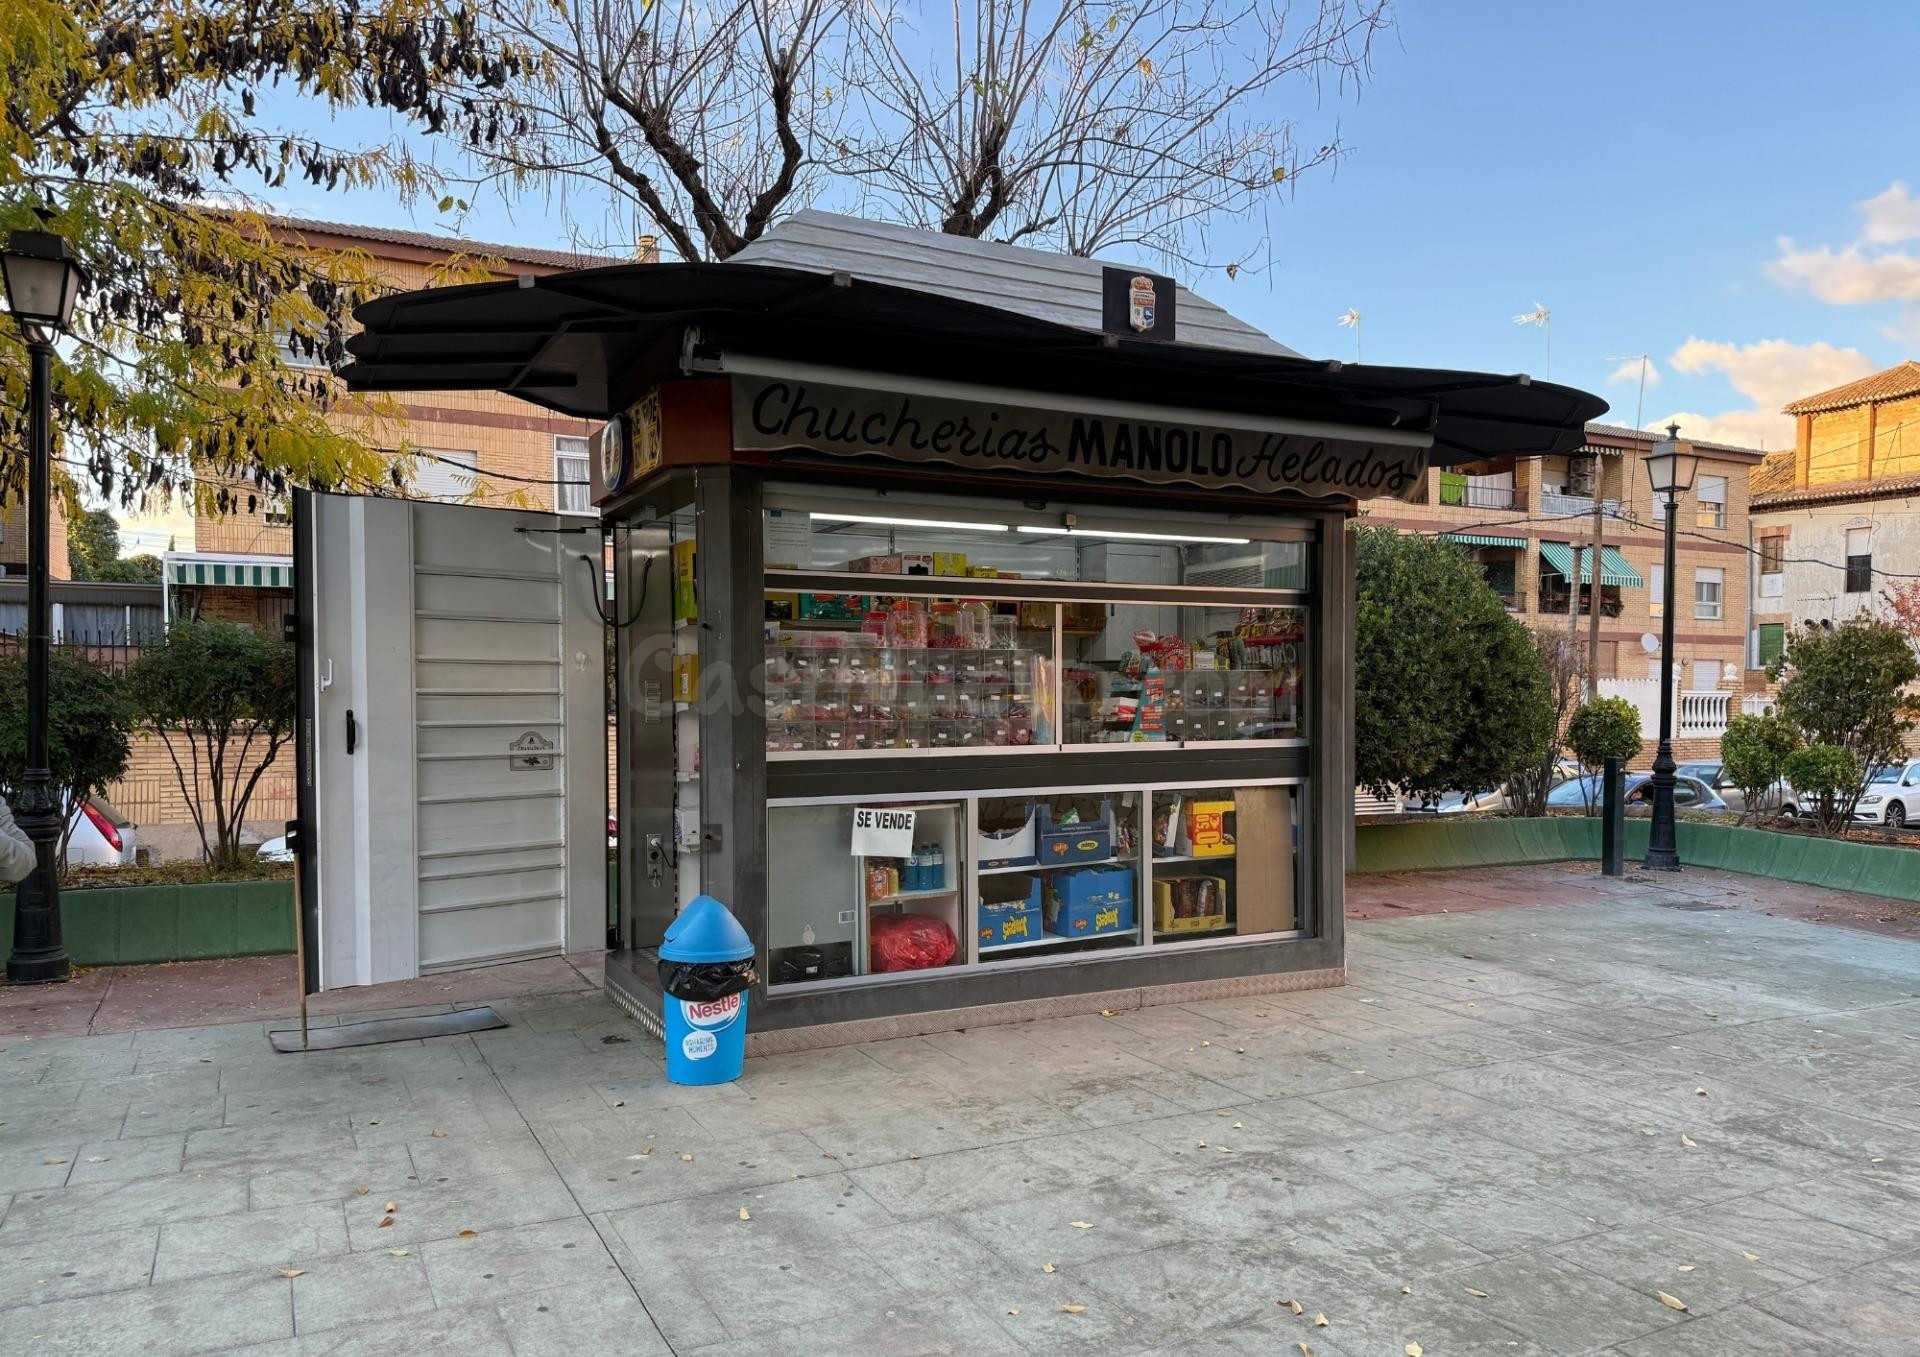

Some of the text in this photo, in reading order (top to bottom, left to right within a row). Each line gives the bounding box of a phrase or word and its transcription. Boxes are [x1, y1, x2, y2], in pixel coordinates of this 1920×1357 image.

[752, 382, 1418, 491] Chucherias MANOLO Helados
[857, 811, 912, 830] SE VENDE
